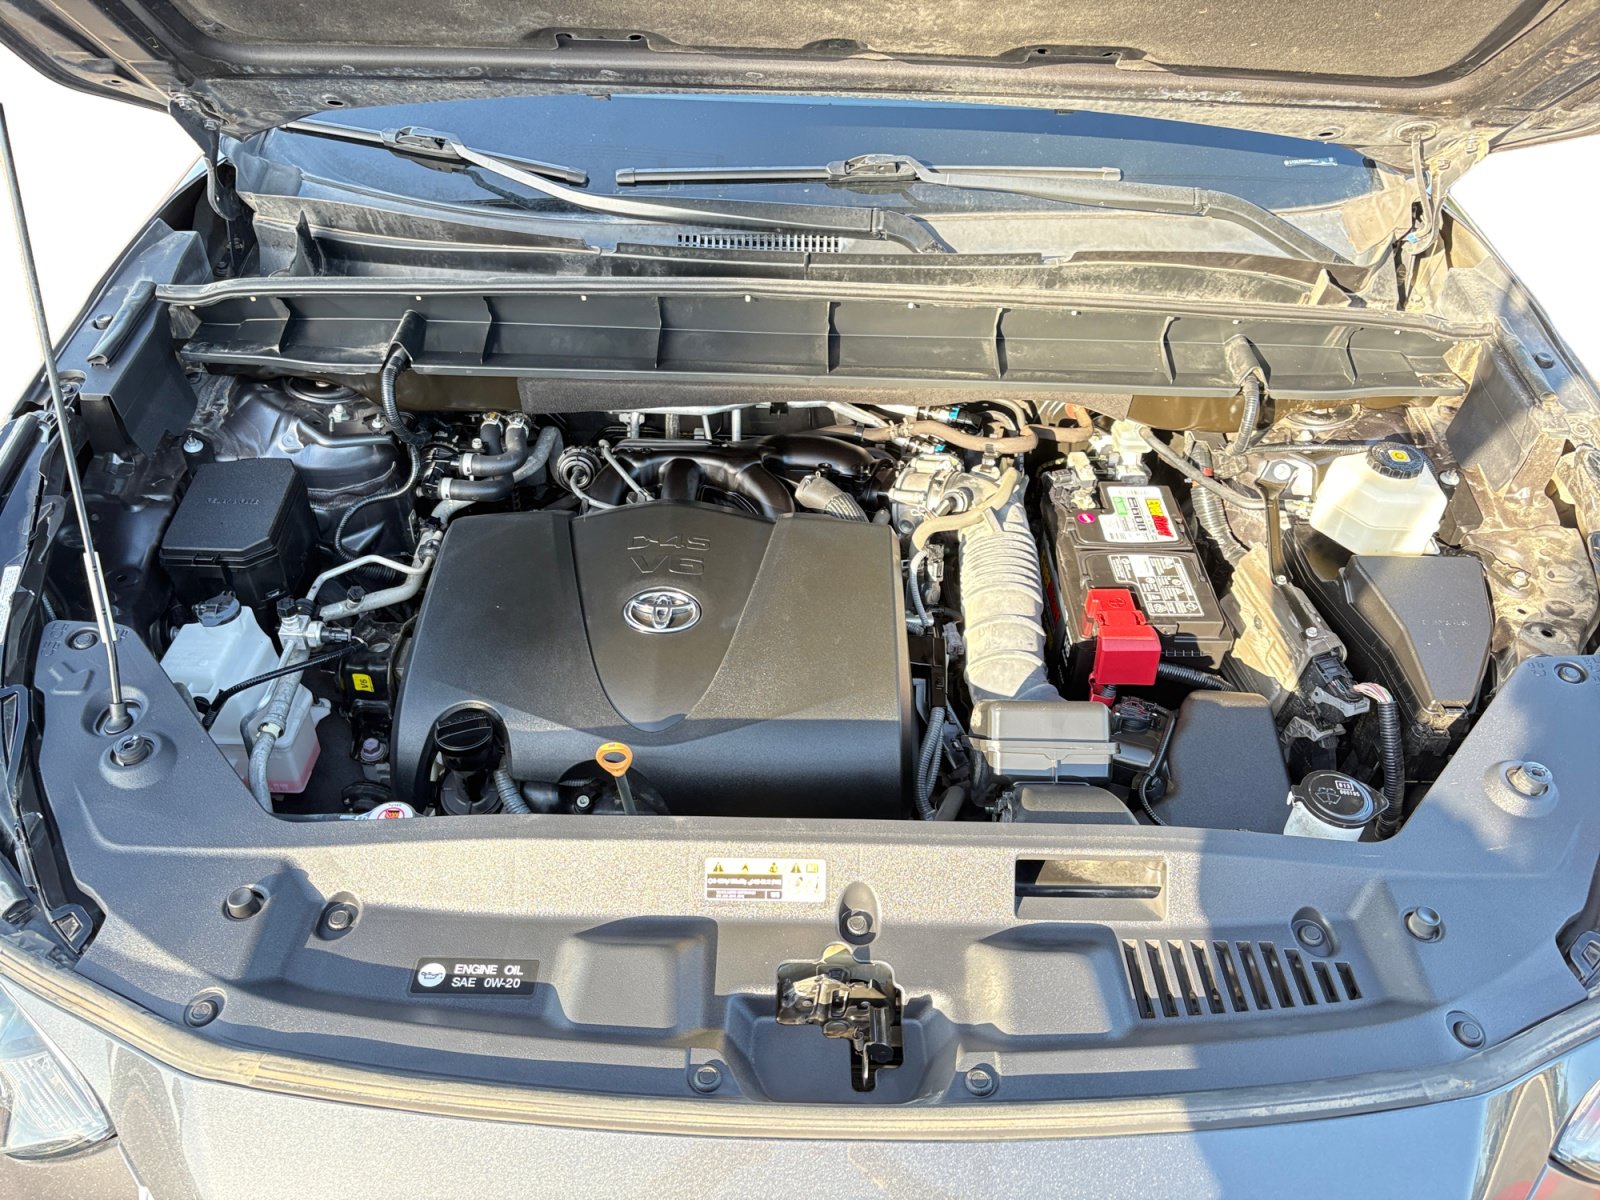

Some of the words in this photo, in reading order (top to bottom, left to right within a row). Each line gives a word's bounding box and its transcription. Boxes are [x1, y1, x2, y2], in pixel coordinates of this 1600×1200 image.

[629, 555, 705, 575] V6
[453, 964, 498, 975] ENGINE
[504, 965, 523, 976] OIL
[450, 977, 476, 988] SAE
[483, 977, 521, 989] 0W-20
